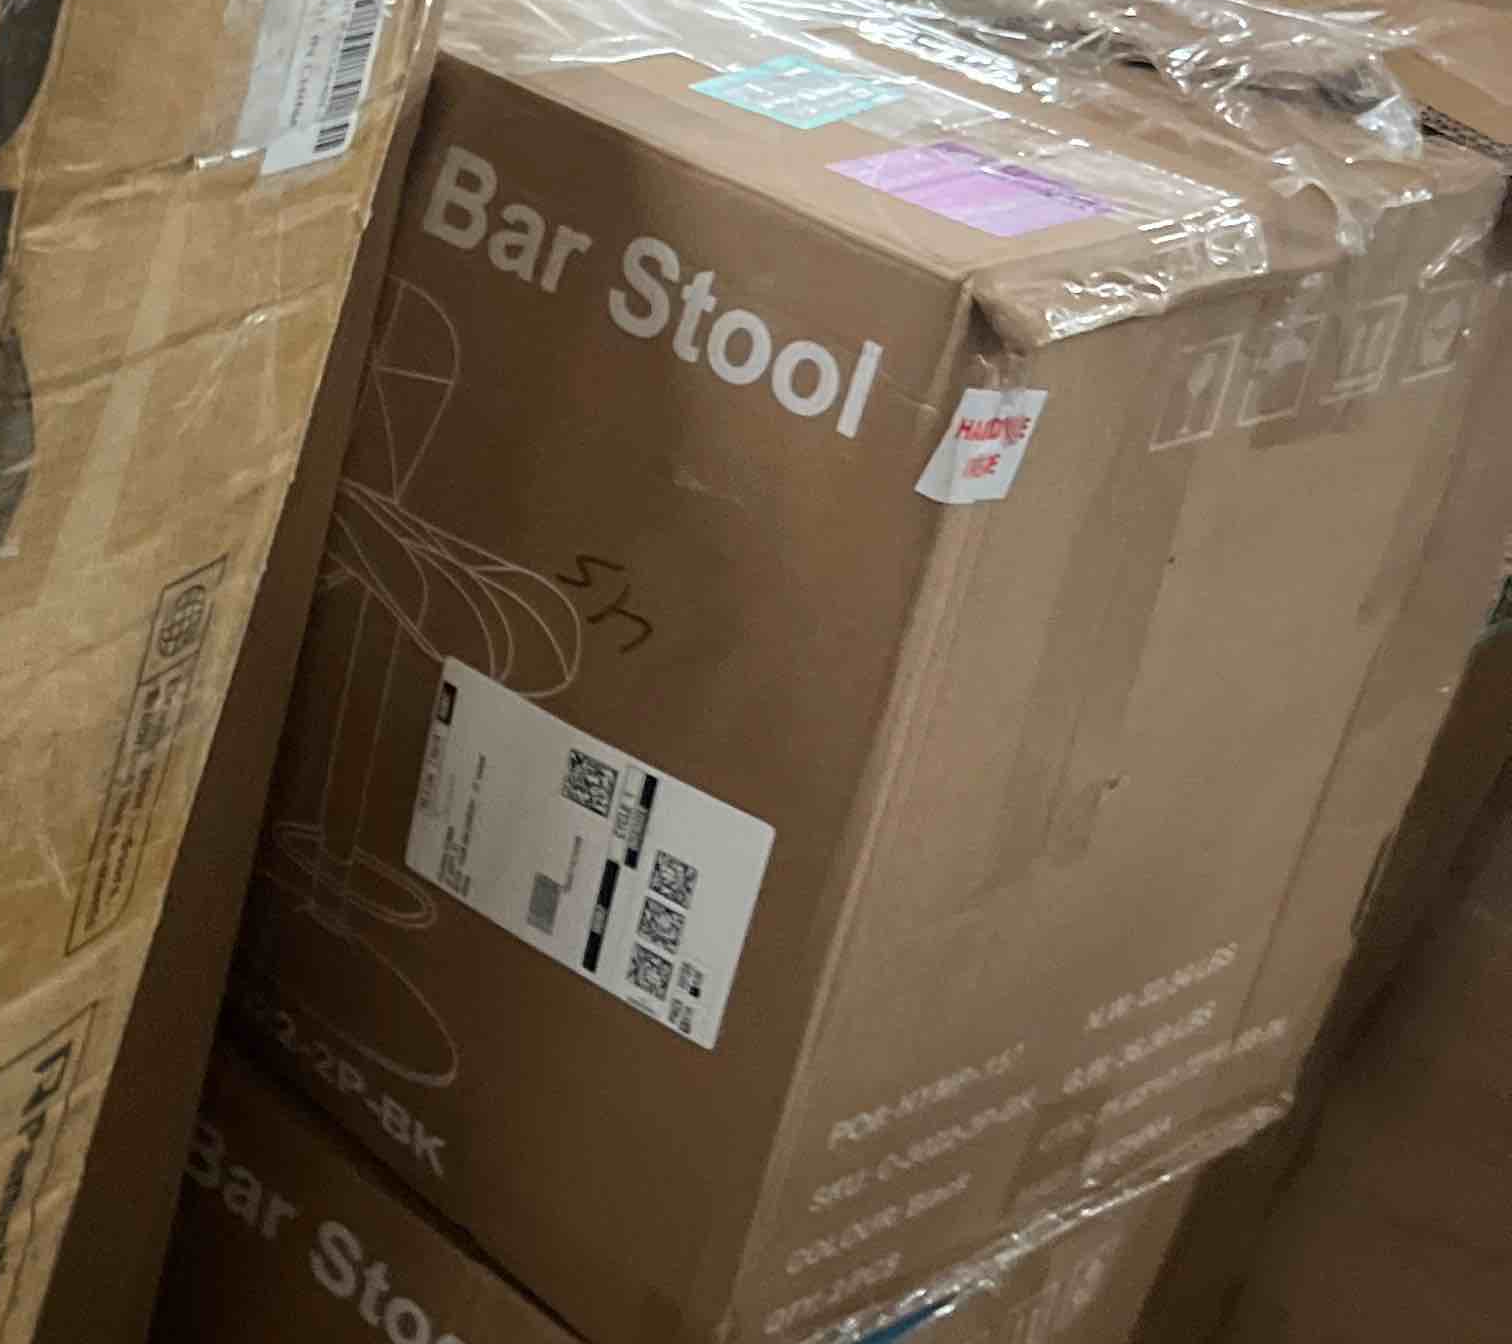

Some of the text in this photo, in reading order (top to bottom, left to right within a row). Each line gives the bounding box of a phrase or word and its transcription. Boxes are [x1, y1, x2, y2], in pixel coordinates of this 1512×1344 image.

[421, 144, 883, 440] Bar Stool
[182, 1122, 298, 1242] Bar
